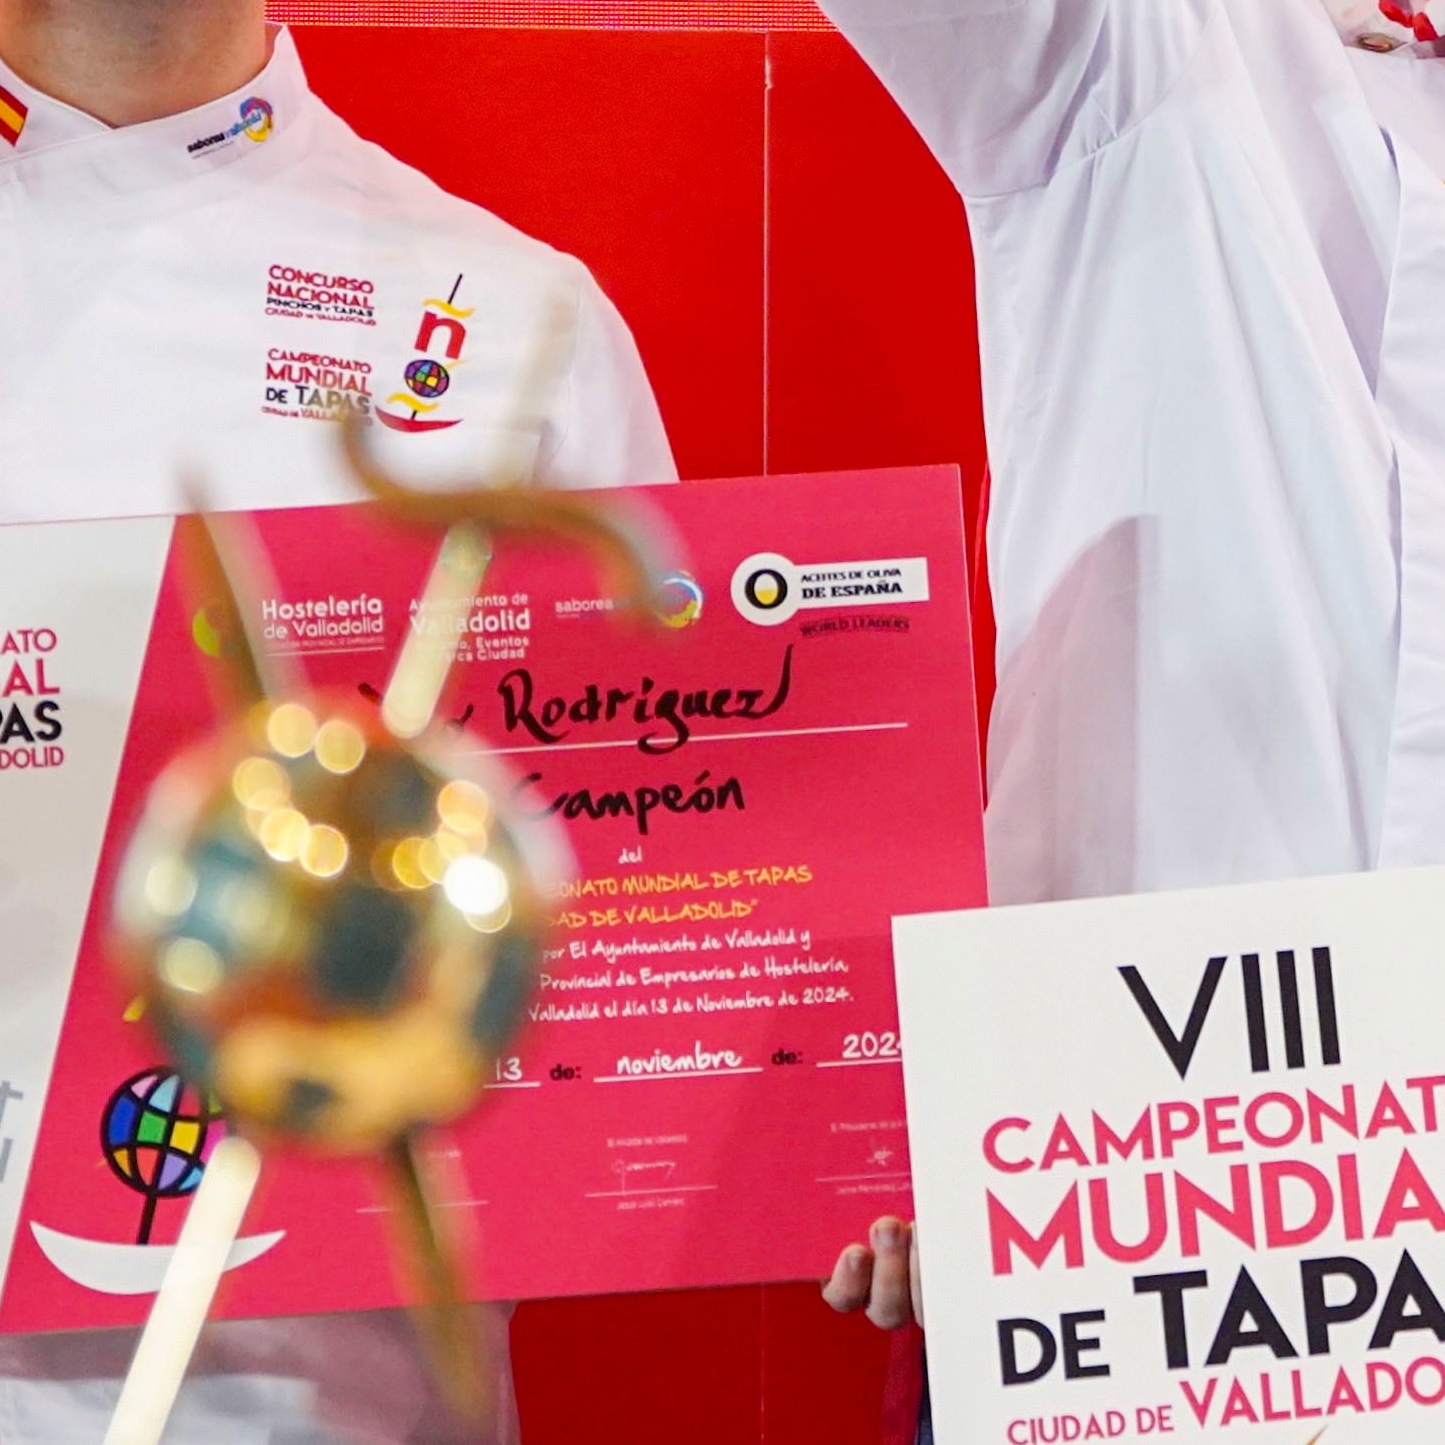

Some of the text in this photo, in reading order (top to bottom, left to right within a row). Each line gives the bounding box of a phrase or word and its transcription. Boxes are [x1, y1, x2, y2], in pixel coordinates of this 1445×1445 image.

[268, 264, 375, 294] CONCURSO
[266, 297, 322, 311] PINCHOS
[333, 305, 373, 317] TAPAS
[267, 281, 375, 311] NACIONAL
[267, 347, 372, 374] CAMPEONATO
[266, 361, 373, 398] MUNDIAL
[265, 384, 371, 416] DE TAPAS
[800, 568, 902, 583] ACEITES DE OLIVA
[802, 579, 903, 600] DE ESPAÑA
[261, 593, 383, 621] Hostelería
[511, 591, 529, 606] de
[263, 616, 384, 640] de Valladolid
[475, 636, 530, 650] Eventos
[476, 647, 526, 661] Ciudad
[618, 846, 642, 865] del
[622, 872, 710, 896] MUNDIAL
[713, 868, 743, 889] DE
[745, 865, 814, 887] TAPAS
[592, 909, 622, 927] DE
[542, 928, 811, 964] por El Ayuntamiento de Valladolid y
[540, 970, 613, 992] Provincial
[615, 970, 637, 987] de
[639, 965, 736, 990] Empresarios
[739, 963, 761, 978] de
[529, 985, 854, 1023] Valladolid el día 13 de Noviembre de 2024.
[1116, 945, 1342, 1082] VIII
[495, 1057, 523, 1081] 13
[616, 1040, 743, 1075] noviembre
[842, 1031, 902, 1059] 202
[996, 1308, 1111, 1387] DE
[1006, 1409, 1126, 1445] CIUDAD
[1136, 1404, 1174, 1434] DE
